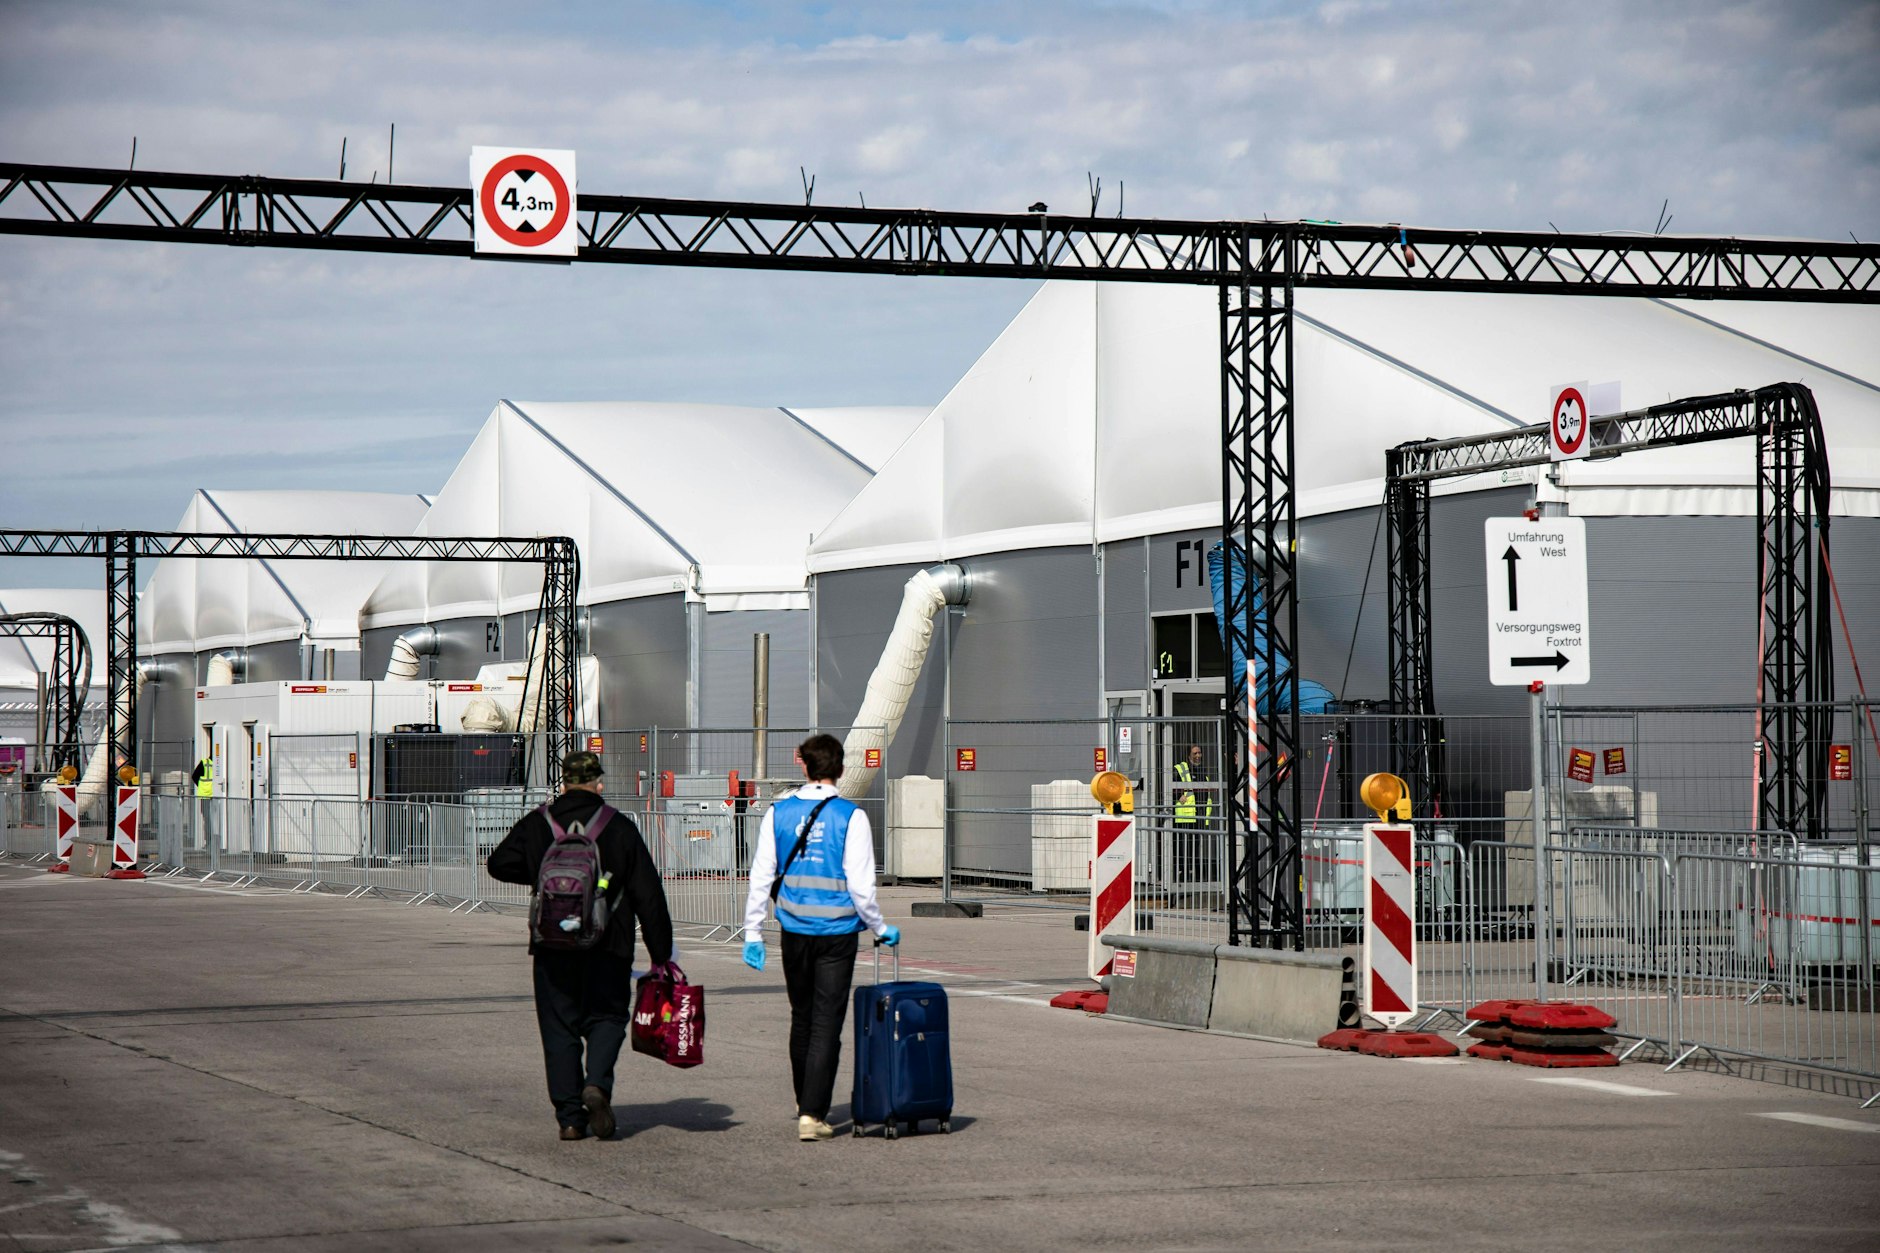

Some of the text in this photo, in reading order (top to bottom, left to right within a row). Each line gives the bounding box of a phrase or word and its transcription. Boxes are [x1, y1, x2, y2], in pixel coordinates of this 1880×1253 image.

[501, 187, 554, 212] 4,3m
[1560, 412, 1580, 430] 3,9m
[1507, 532, 1564, 544] Umfahrung
[1540, 547, 1567, 557] West
[1176, 539, 1204, 589] F1
[486, 621, 500, 653] F2
[1496, 622, 1581, 635] Versorgungsweg
[1546, 636, 1582, 647] Foxtrot
[1160, 651, 1173, 674] F1
[678, 994, 691, 1056] ROSSMANN
